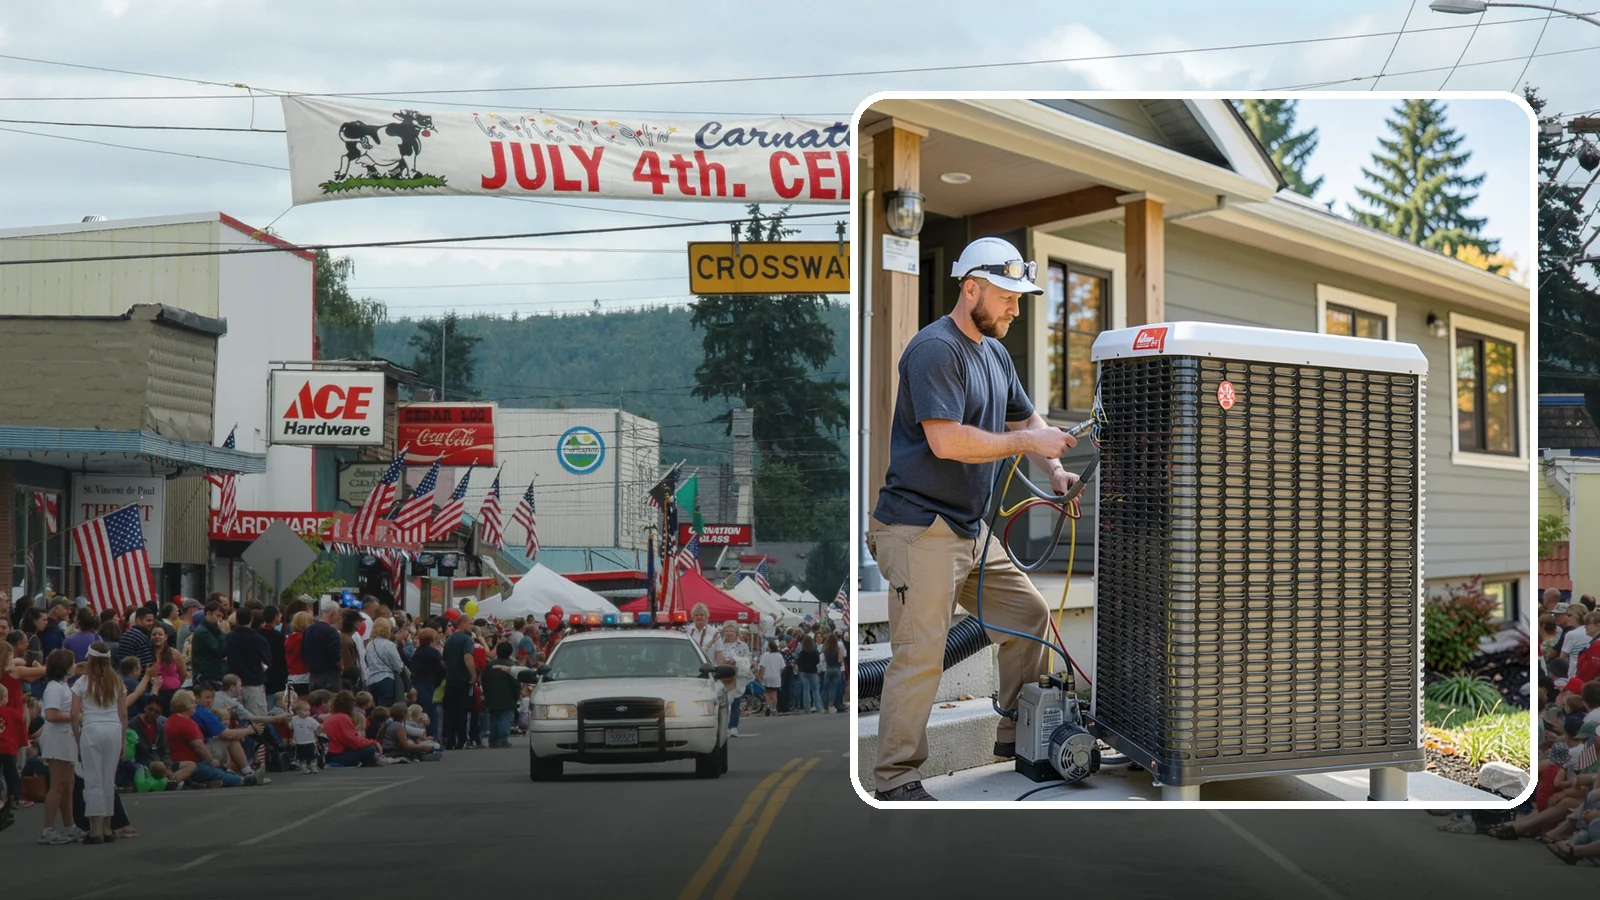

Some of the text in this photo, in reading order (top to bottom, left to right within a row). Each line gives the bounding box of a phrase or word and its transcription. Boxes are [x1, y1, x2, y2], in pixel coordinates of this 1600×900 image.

[481, 141, 605, 192] JULY
[632, 150, 746, 198] 4th.
[697, 254, 850, 280] CROSSWA
[283, 380, 373, 420] ACE
[405, 409, 485, 422] CEDAR LOG
[283, 421, 370, 436] Hardware
[416, 428, 477, 446] Coca-Cola
[83, 485, 155, 495] St. Vincent de Paul
[688, 526, 741, 535] CRNATION
[699, 535, 730, 543] GLASS
